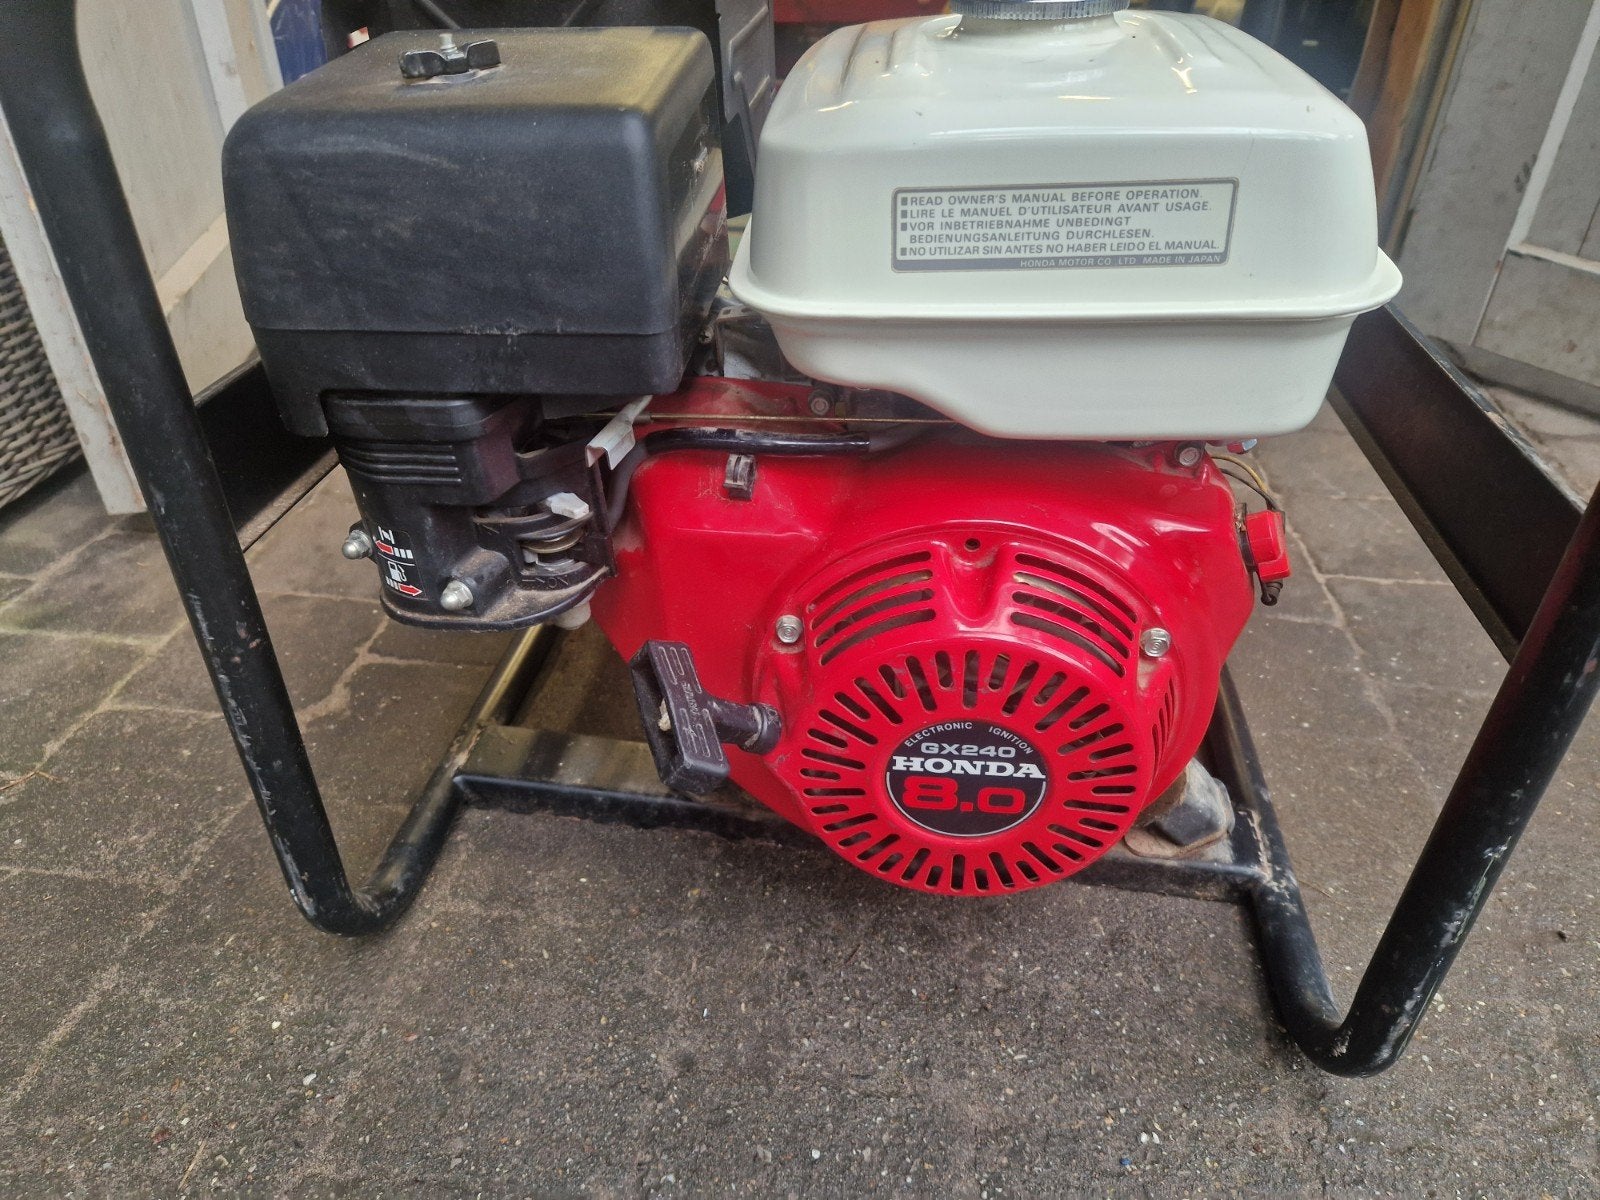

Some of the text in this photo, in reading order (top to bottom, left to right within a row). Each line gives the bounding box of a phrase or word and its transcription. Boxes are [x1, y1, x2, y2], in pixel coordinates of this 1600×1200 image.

[910, 196, 943, 206] READ
[948, 194, 1006, 205] OWNER'S
[1012, 193, 1065, 203] MANUAL
[1072, 191, 1120, 201] BEFORE
[910, 209, 935, 218] LIRE
[941, 209, 954, 217] LE
[960, 207, 1012, 217] MANUEL
[1019, 203, 1111, 215] D'UTILISATEUR
[1118, 202, 1160, 212] AVANT
[910, 216, 1131, 231] VOR INBETRIEBNAHME UNBEDINGT
[910, 229, 1154, 243] BEDIENUNGSANLEITUNG DURCHLESEN.
[909, 240, 1219, 256] NO UTILIZAR SIN ANTES NO HABER LEIDO EL MANUAL.
[1020, 259, 1055, 267] HONDA
[1058, 258, 1094, 267] MOTOR
[1143, 256, 1172, 264] MADE
[1188, 255, 1221, 263] JAPAN
[904, 722, 1034, 755] ELECTRONIC IGNITION
[921, 742, 1016, 758] GX240
[892, 755, 1046, 778] HONDA
[903, 776, 1026, 813] 8.0
